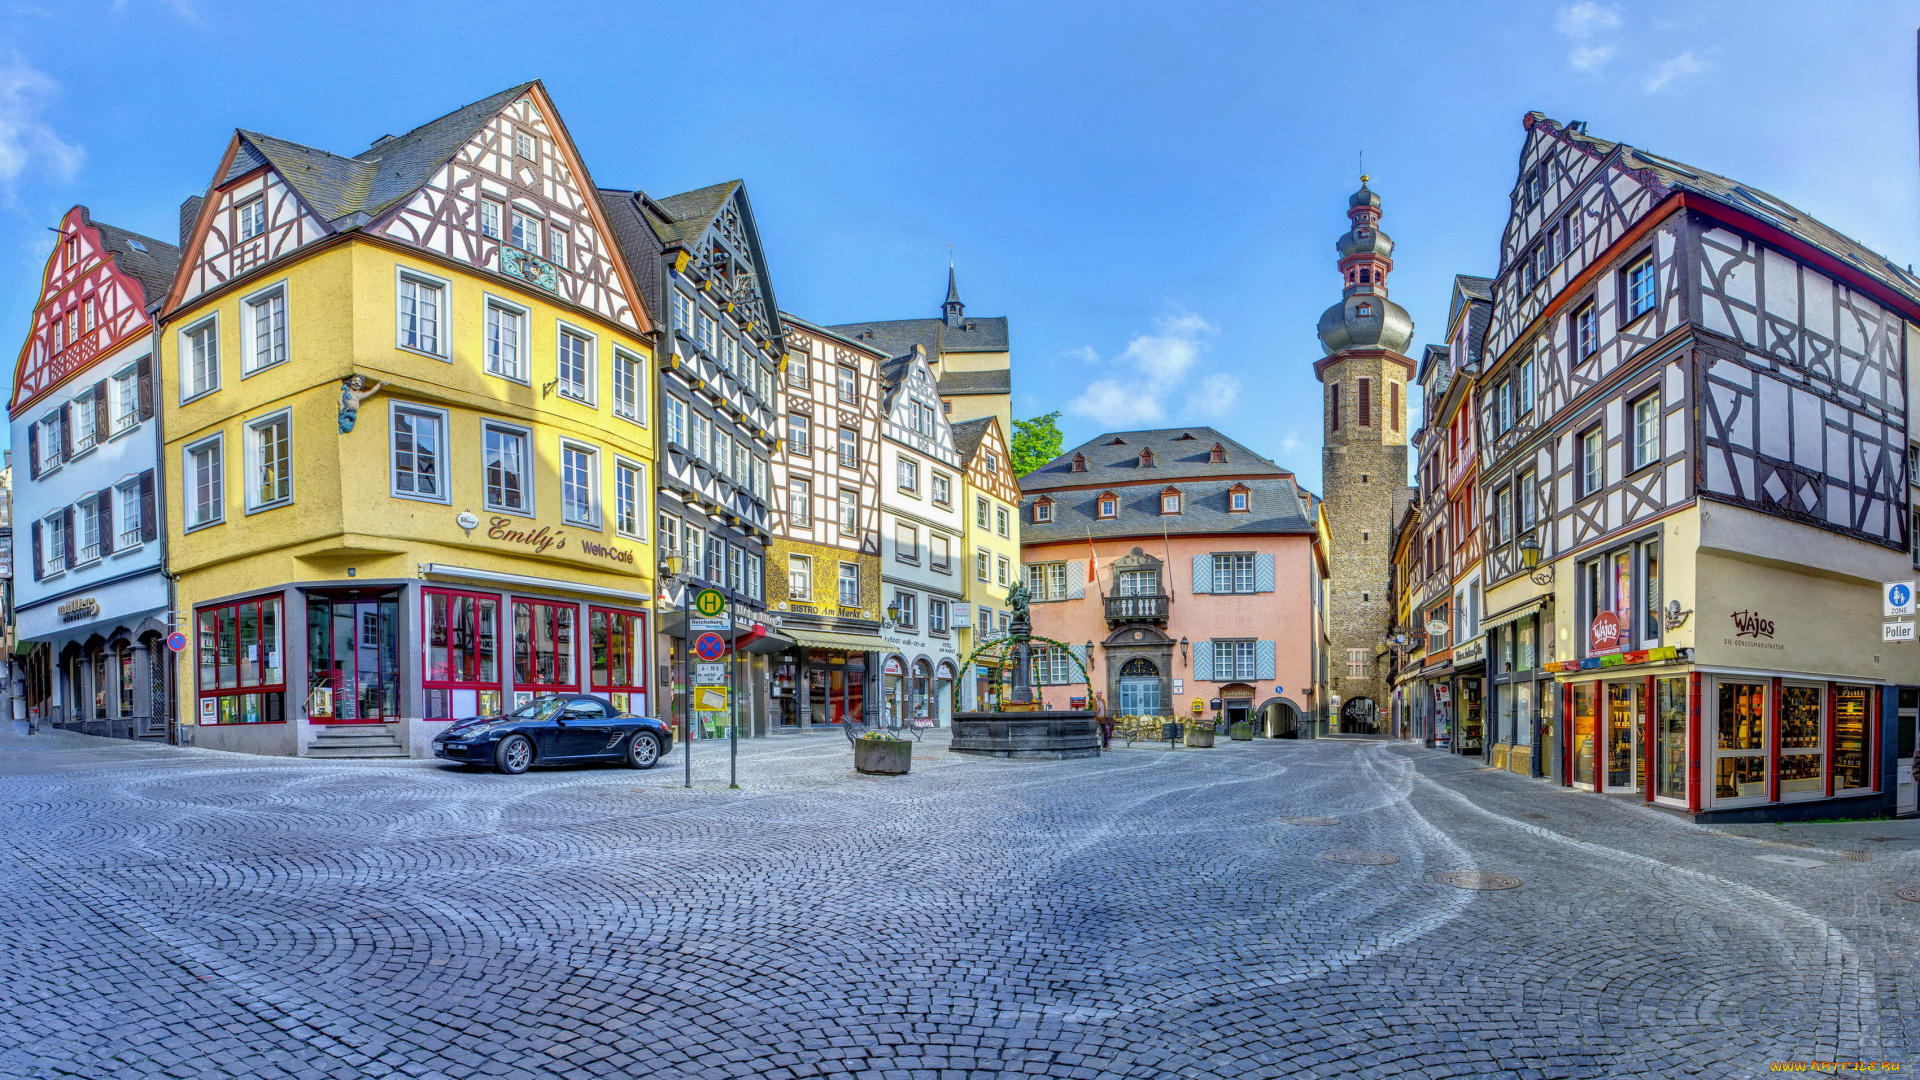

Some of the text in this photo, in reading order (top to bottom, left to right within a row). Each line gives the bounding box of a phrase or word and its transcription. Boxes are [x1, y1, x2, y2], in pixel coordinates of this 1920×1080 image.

[581, 539, 634, 564] Wein-Café
[704, 595, 716, 610] H
[790, 604, 819, 615] BISTRO
[821, 606, 835, 616] Am
[836, 607, 861, 619] Markt
[1885, 625, 1912, 638] Poller
[1723, 638, 1785, 651] DIE GENUSSMANUFAKTUR
